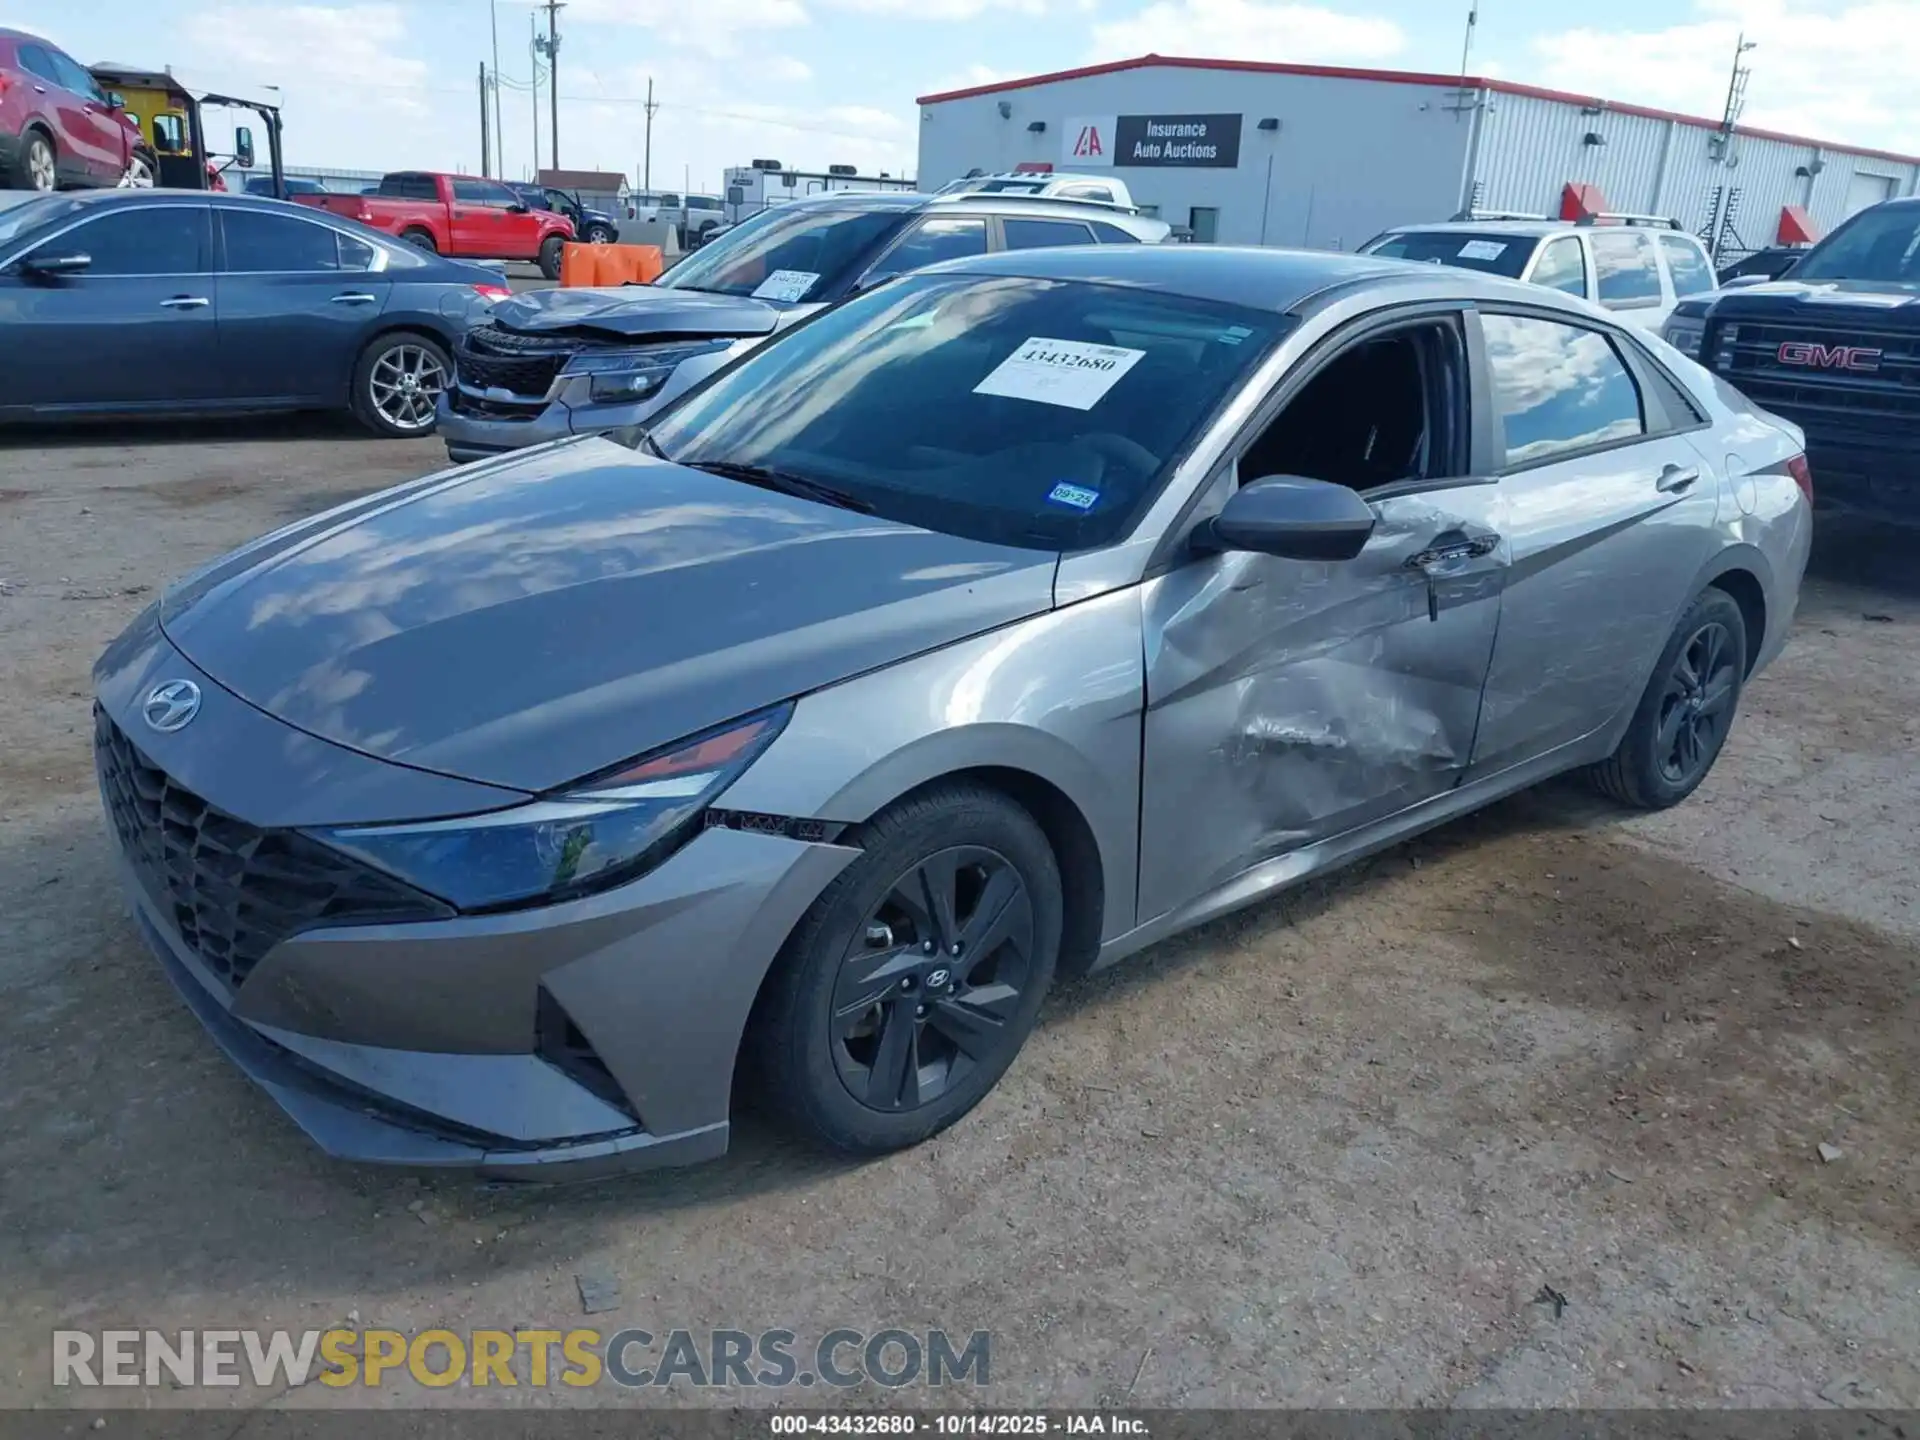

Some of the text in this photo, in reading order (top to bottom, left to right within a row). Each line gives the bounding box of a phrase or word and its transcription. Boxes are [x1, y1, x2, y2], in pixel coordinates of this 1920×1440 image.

[1147, 120, 1207, 137] Insurance
[1133, 141, 1217, 158] Auto Auctions
[1022, 349, 1116, 372] 43432680
[1777, 341, 1883, 372] GMC
